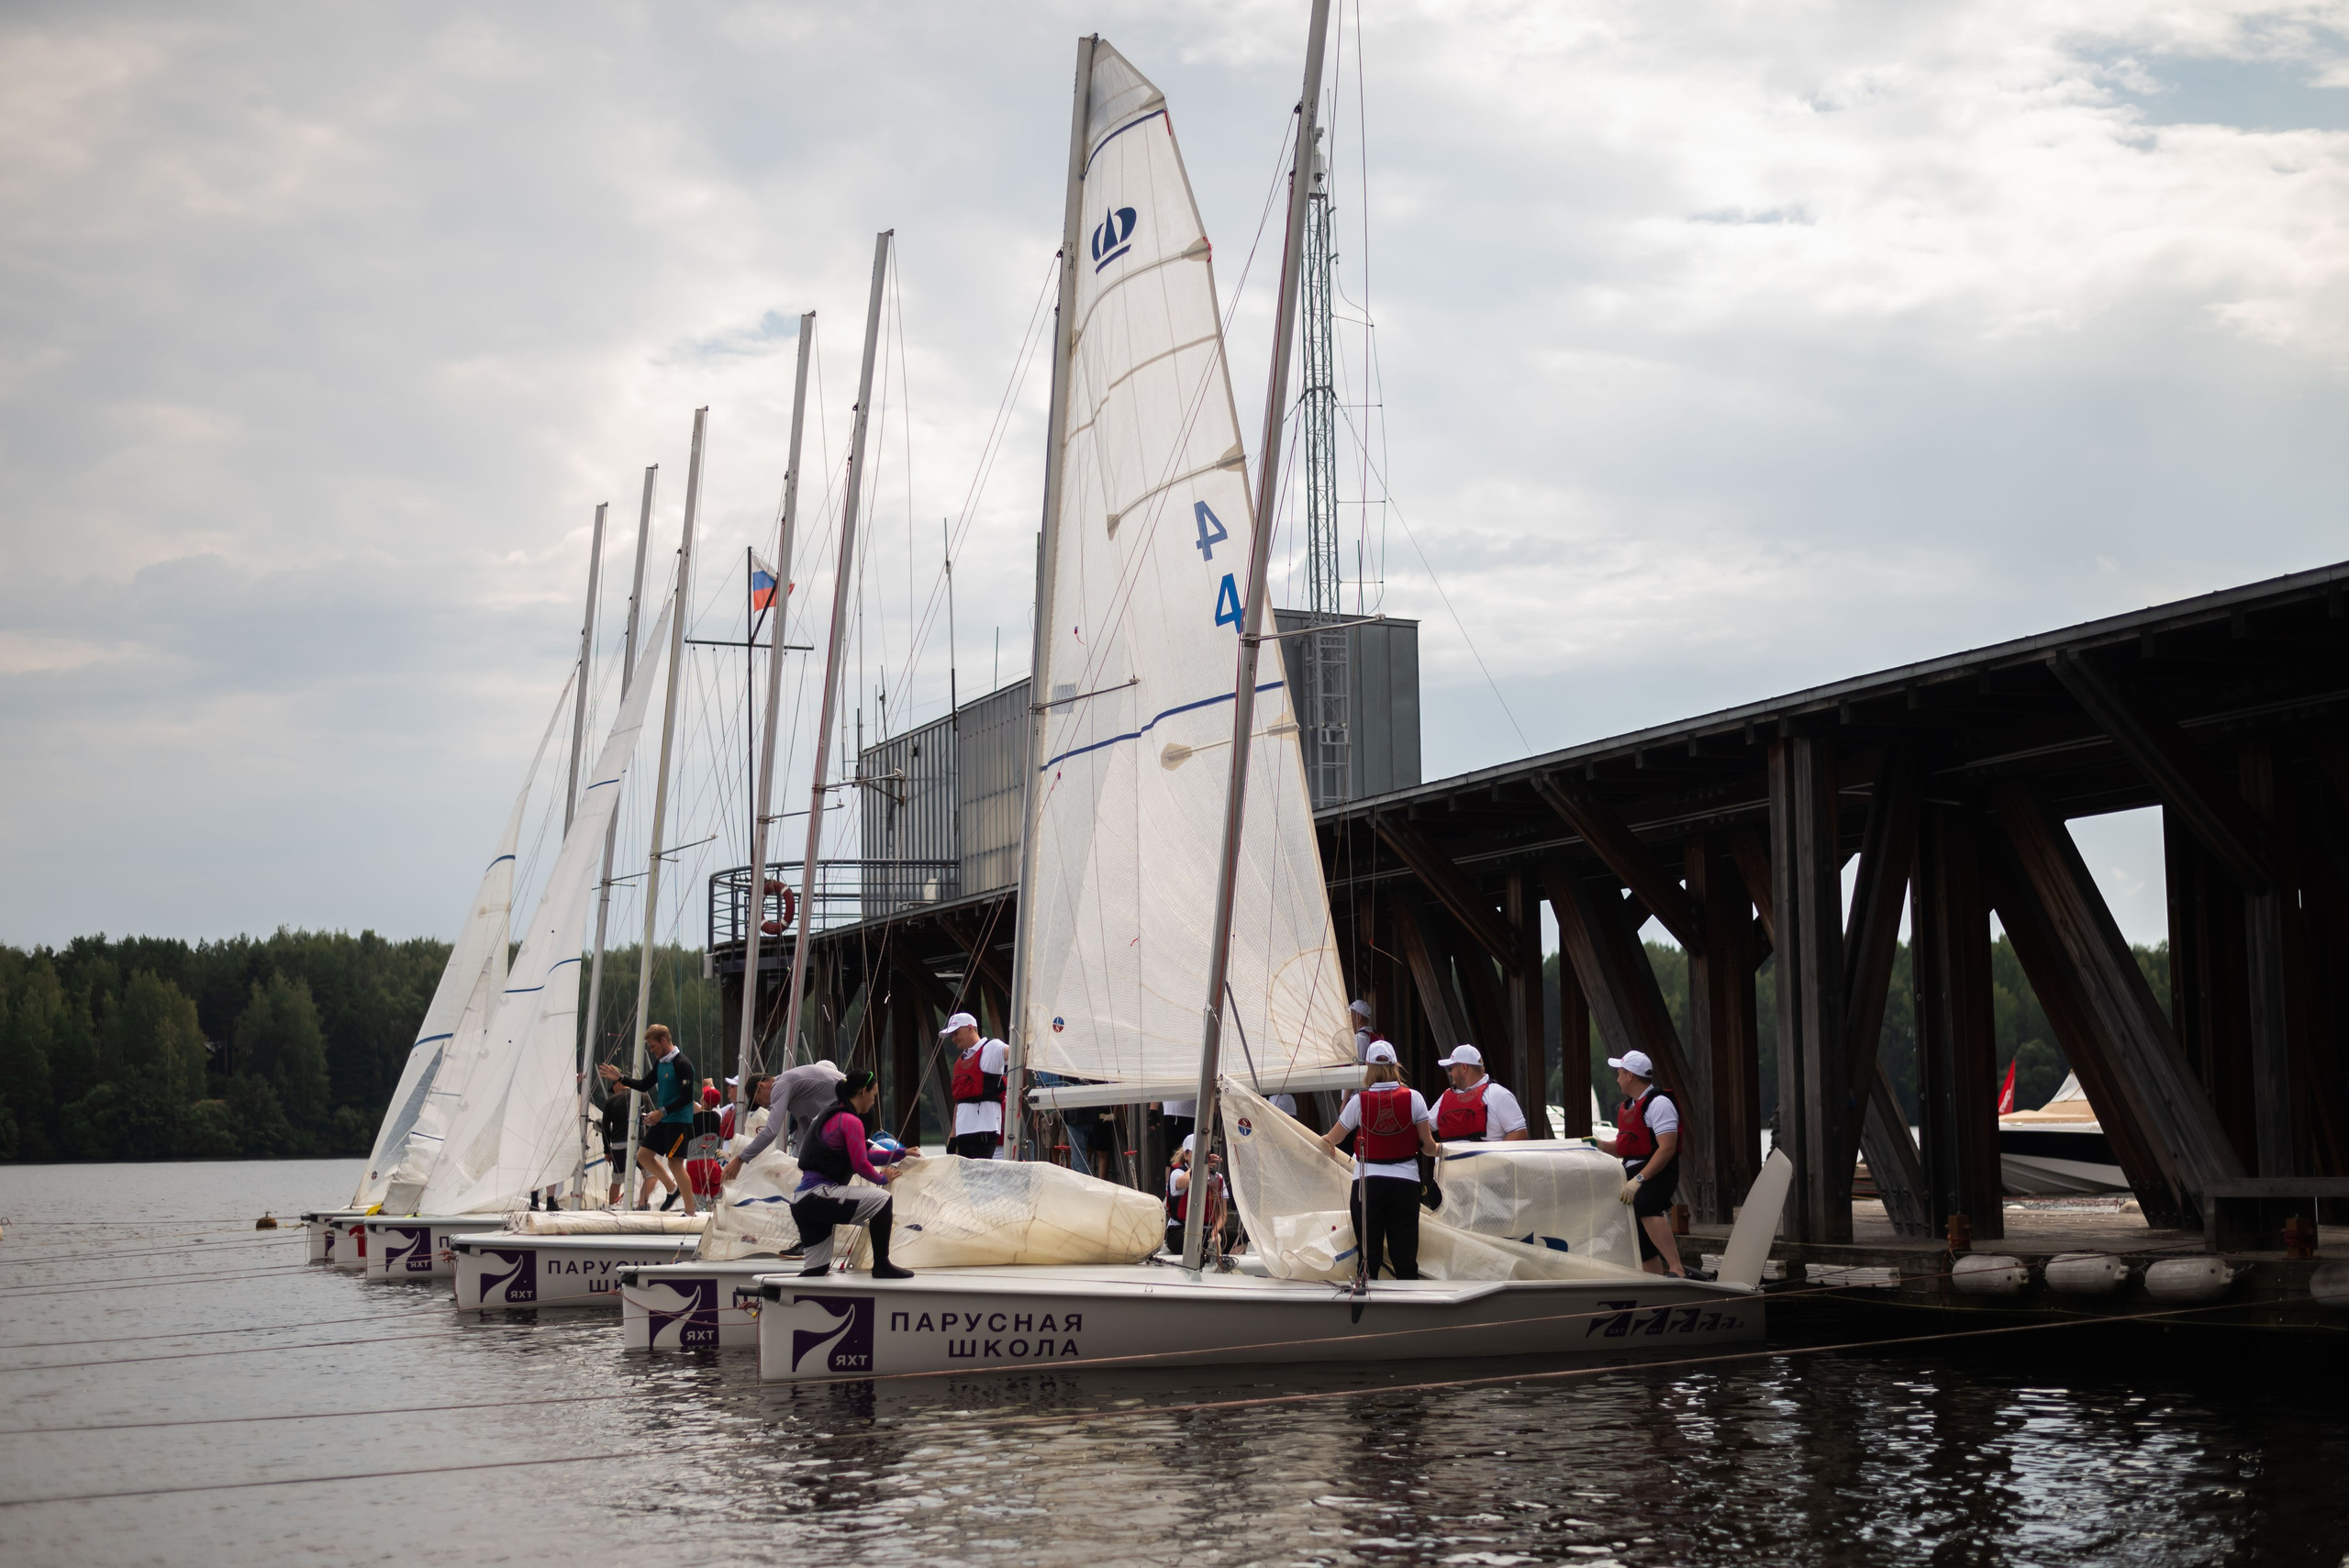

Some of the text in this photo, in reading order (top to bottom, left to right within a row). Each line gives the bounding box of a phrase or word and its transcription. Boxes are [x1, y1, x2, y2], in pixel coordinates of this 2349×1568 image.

[1215, 573, 1245, 634] 4
[510, 1290, 533, 1299] ЯХТ
[890, 1312, 1084, 1333] ПАРУСНАЯ
[686, 1330, 715, 1341] ЯХТ
[948, 1338, 1080, 1359] ШКОЛА
[835, 1354, 869, 1367] ЯХТ
